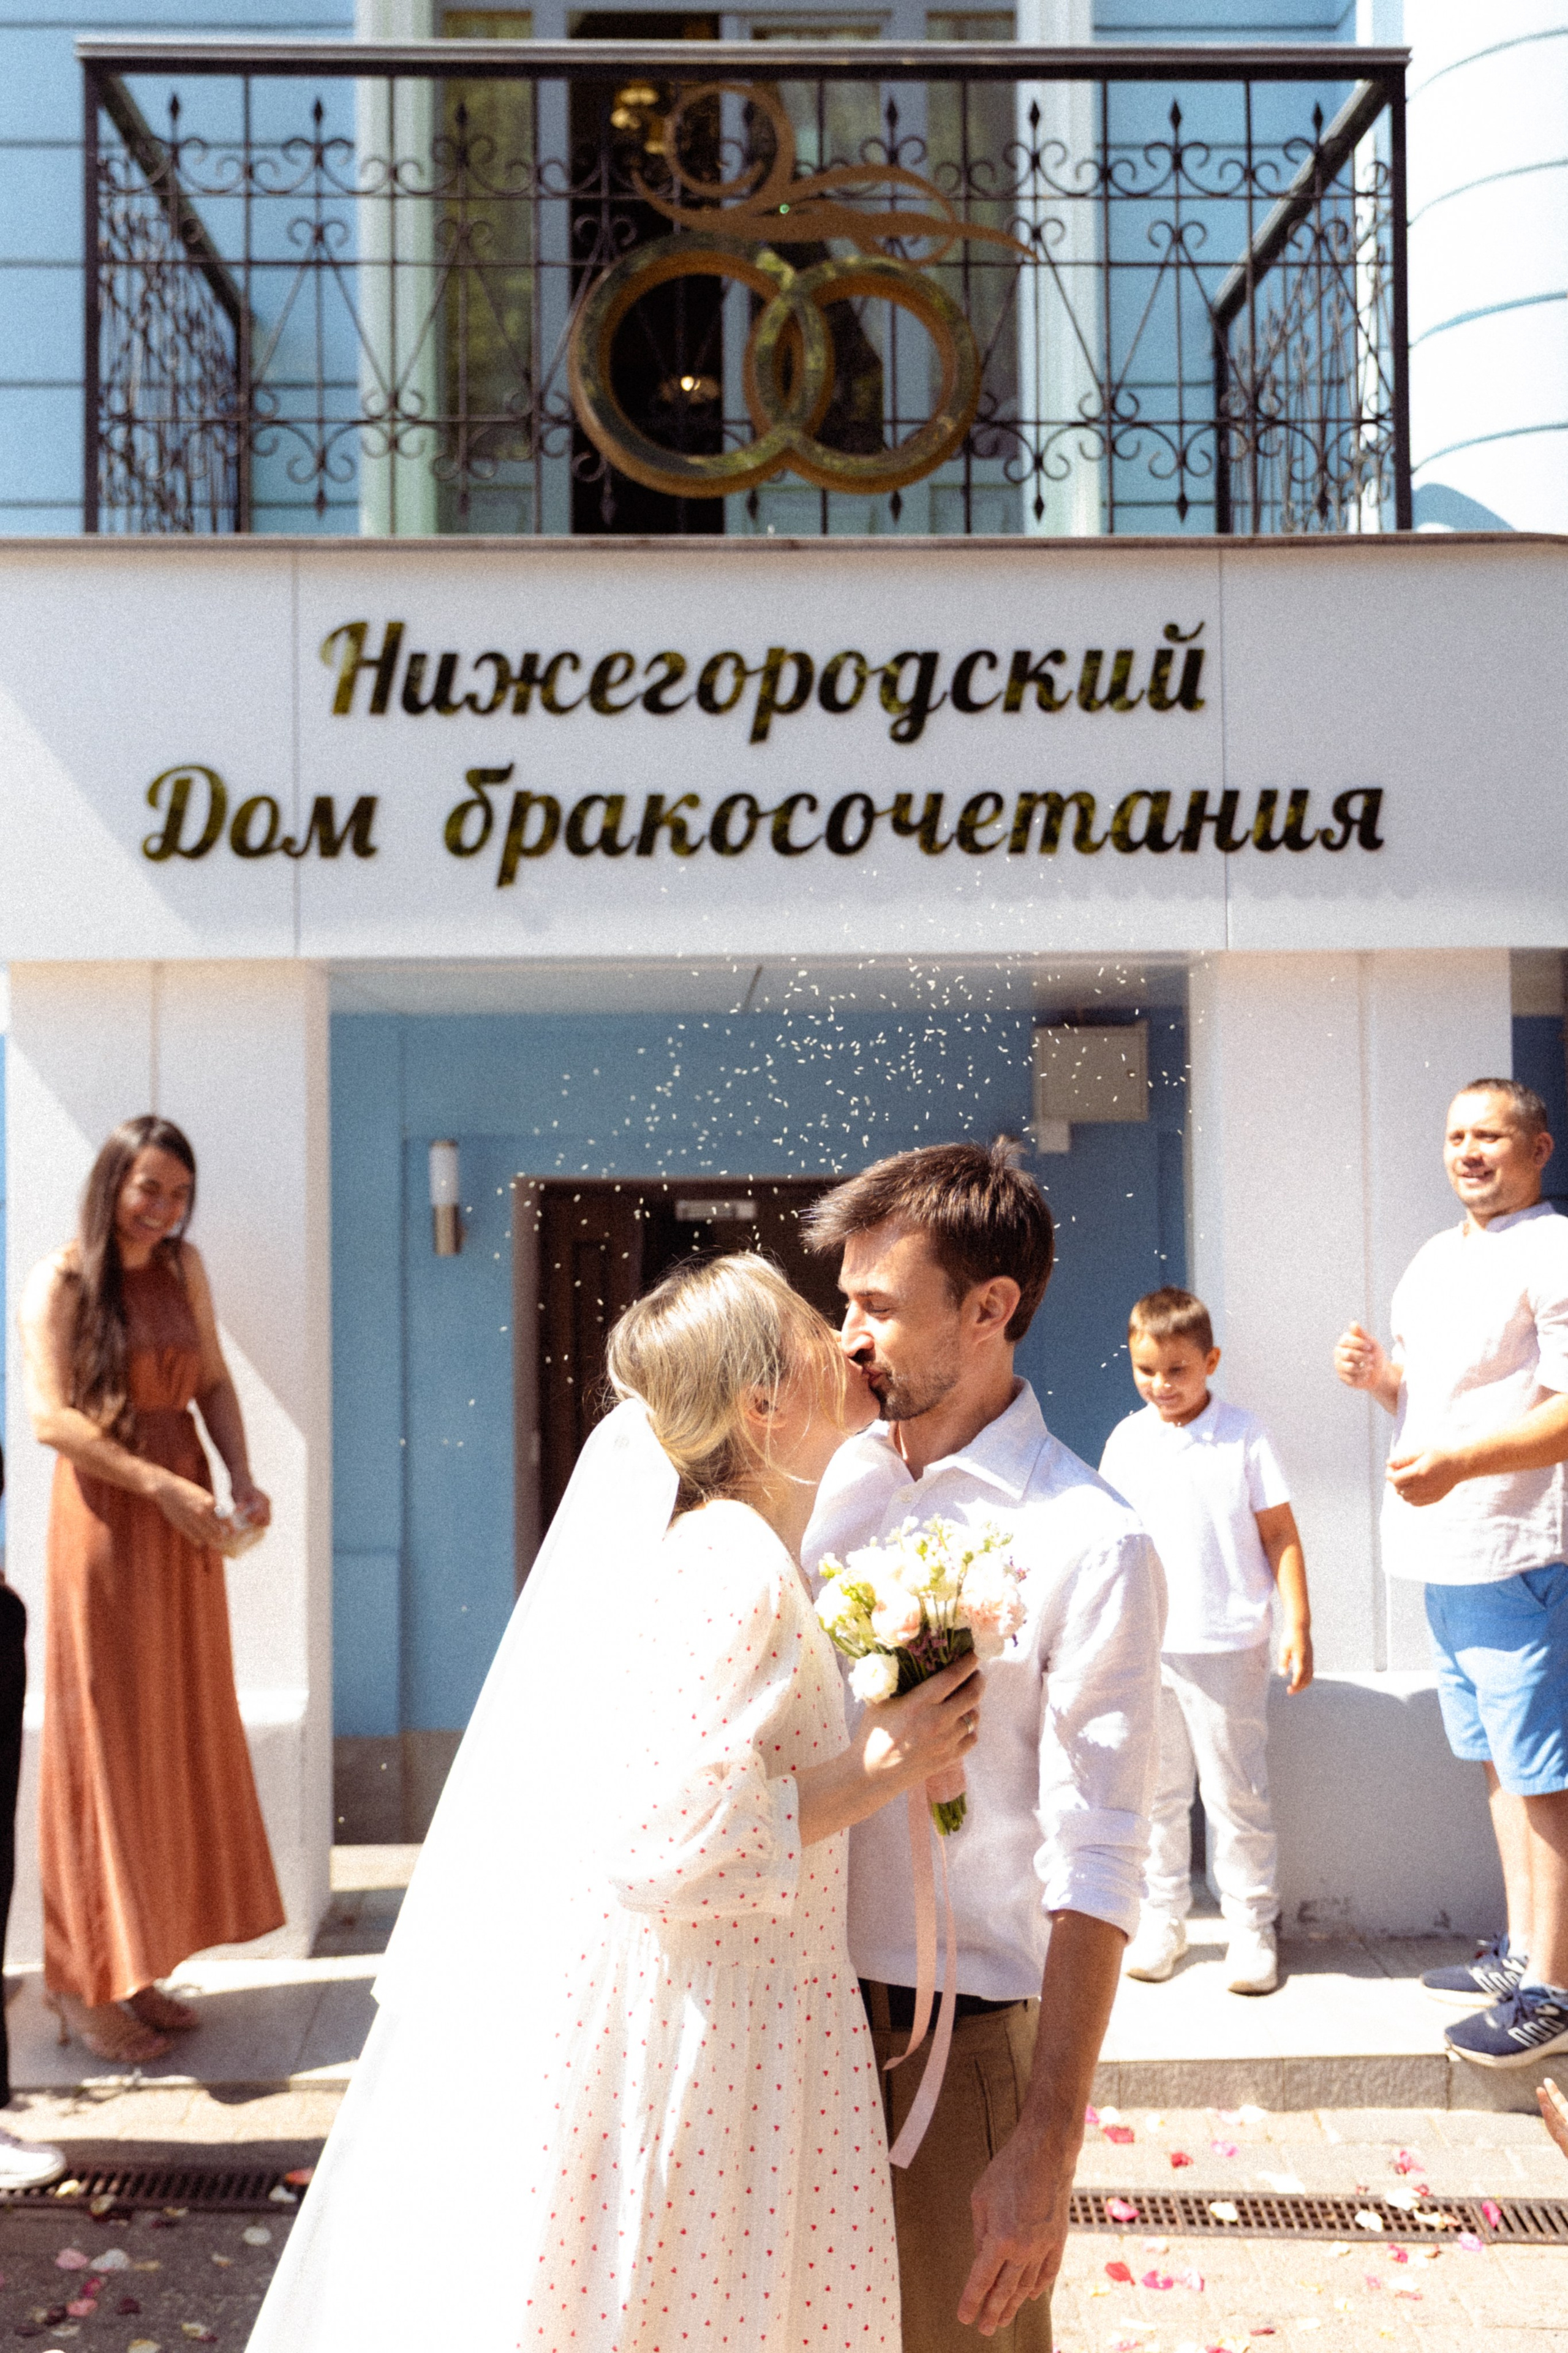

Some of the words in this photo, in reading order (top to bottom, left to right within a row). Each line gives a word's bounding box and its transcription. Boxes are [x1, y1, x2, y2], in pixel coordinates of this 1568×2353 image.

[320, 619, 1207, 747] Нижегородский
[142, 765, 379, 863] Дом
[442, 761, 1385, 889] бракосочетания
